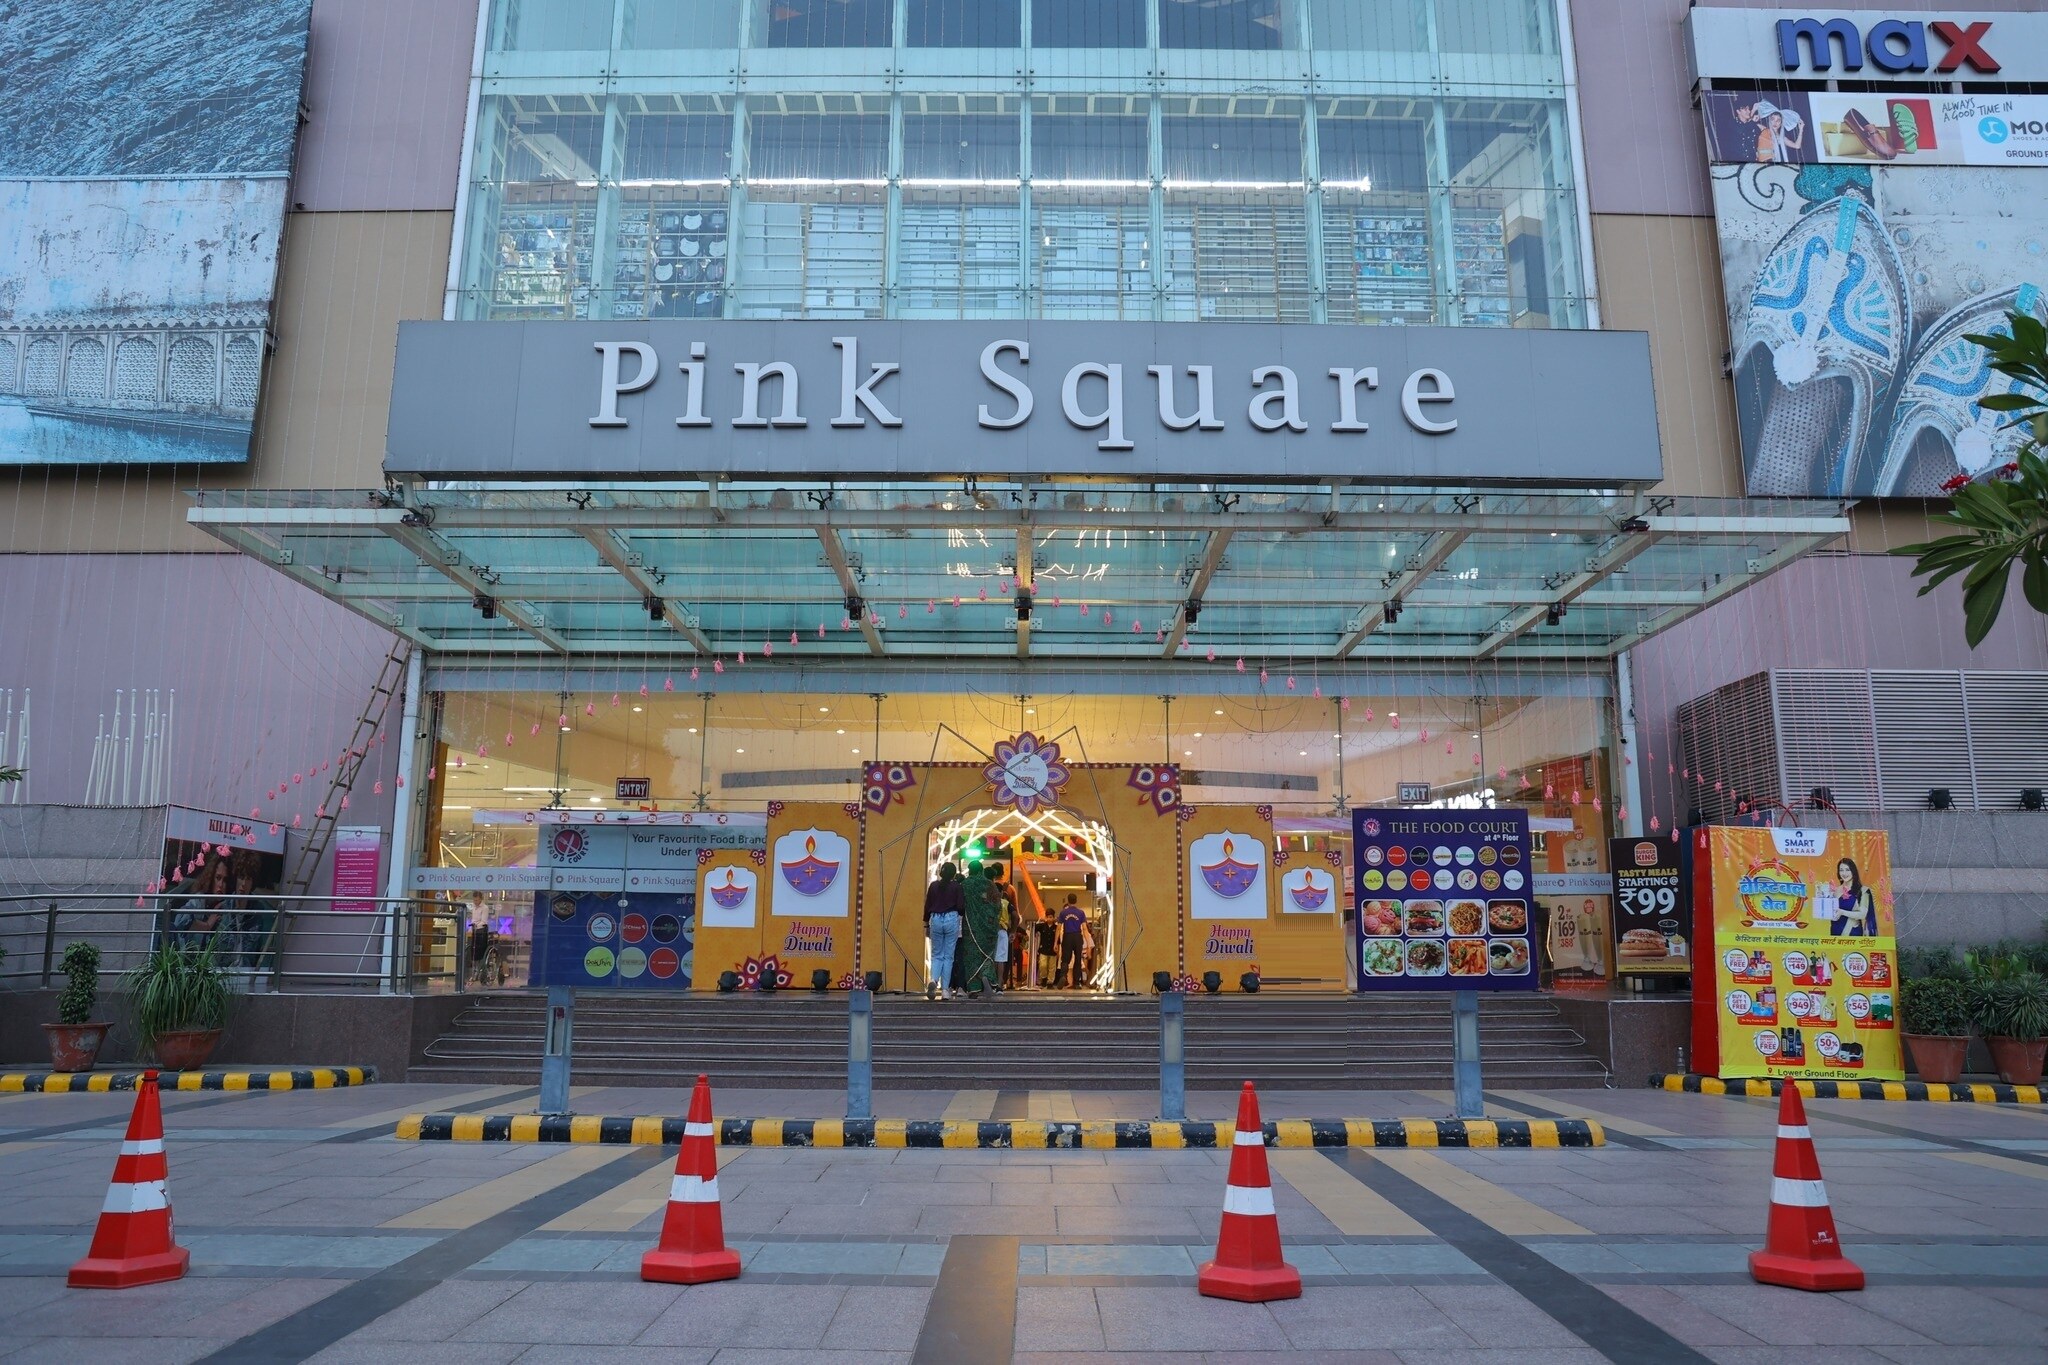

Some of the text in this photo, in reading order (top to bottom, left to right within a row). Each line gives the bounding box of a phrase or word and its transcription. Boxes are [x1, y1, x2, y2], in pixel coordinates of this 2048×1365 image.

[1776, 17, 2002, 74] max
[1942, 97, 1976, 113] ALWAYS
[1943, 101, 2013, 123] A GOOD TIME IN
[2010, 120, 2048, 135] MO
[2006, 150, 2043, 158] GROUND
[588, 336, 1459, 451] Pink Square
[618, 782, 647, 796] ENTRY
[1401, 787, 1427, 801] EXIT
[209, 819, 241, 835] KILLE
[1389, 821, 1418, 834] THE
[1423, 821, 1465, 834] FOOD
[1468, 821, 1518, 834] COURT
[632, 833, 656, 844] Your
[658, 834, 707, 844] Favourite
[710, 834, 735, 844] Food
[1784, 838, 1814, 848] SMART
[661, 847, 692, 856] Under
[429, 874, 480, 884] Pink Square
[497, 874, 550, 884] Pink Square
[567, 874, 620, 885] Pink Square
[1618, 868, 1678, 878] TASTY MEALS
[643, 876, 697, 887] Pink Square
[1532, 880, 1557, 889] quare
[1569, 879, 1588, 887] Pink
[1590, 879, 1611, 889] Squa
[1618, 876, 1679, 887] STARTING @
[1739, 875, 1807, 897] बेस्टिवल
[1760, 895, 1787, 911] सेल
[1557, 904, 1566, 921] 2
[790, 921, 831, 938] Happy
[1209, 924, 1251, 940] Happy
[783, 935, 833, 951] Diwali
[1205, 938, 1254, 954] Diwali
[1820, 1038, 1838, 1047] 50%
[1804, 1069, 1834, 1077] Ground
[1836, 1070, 1858, 1078] Floor
